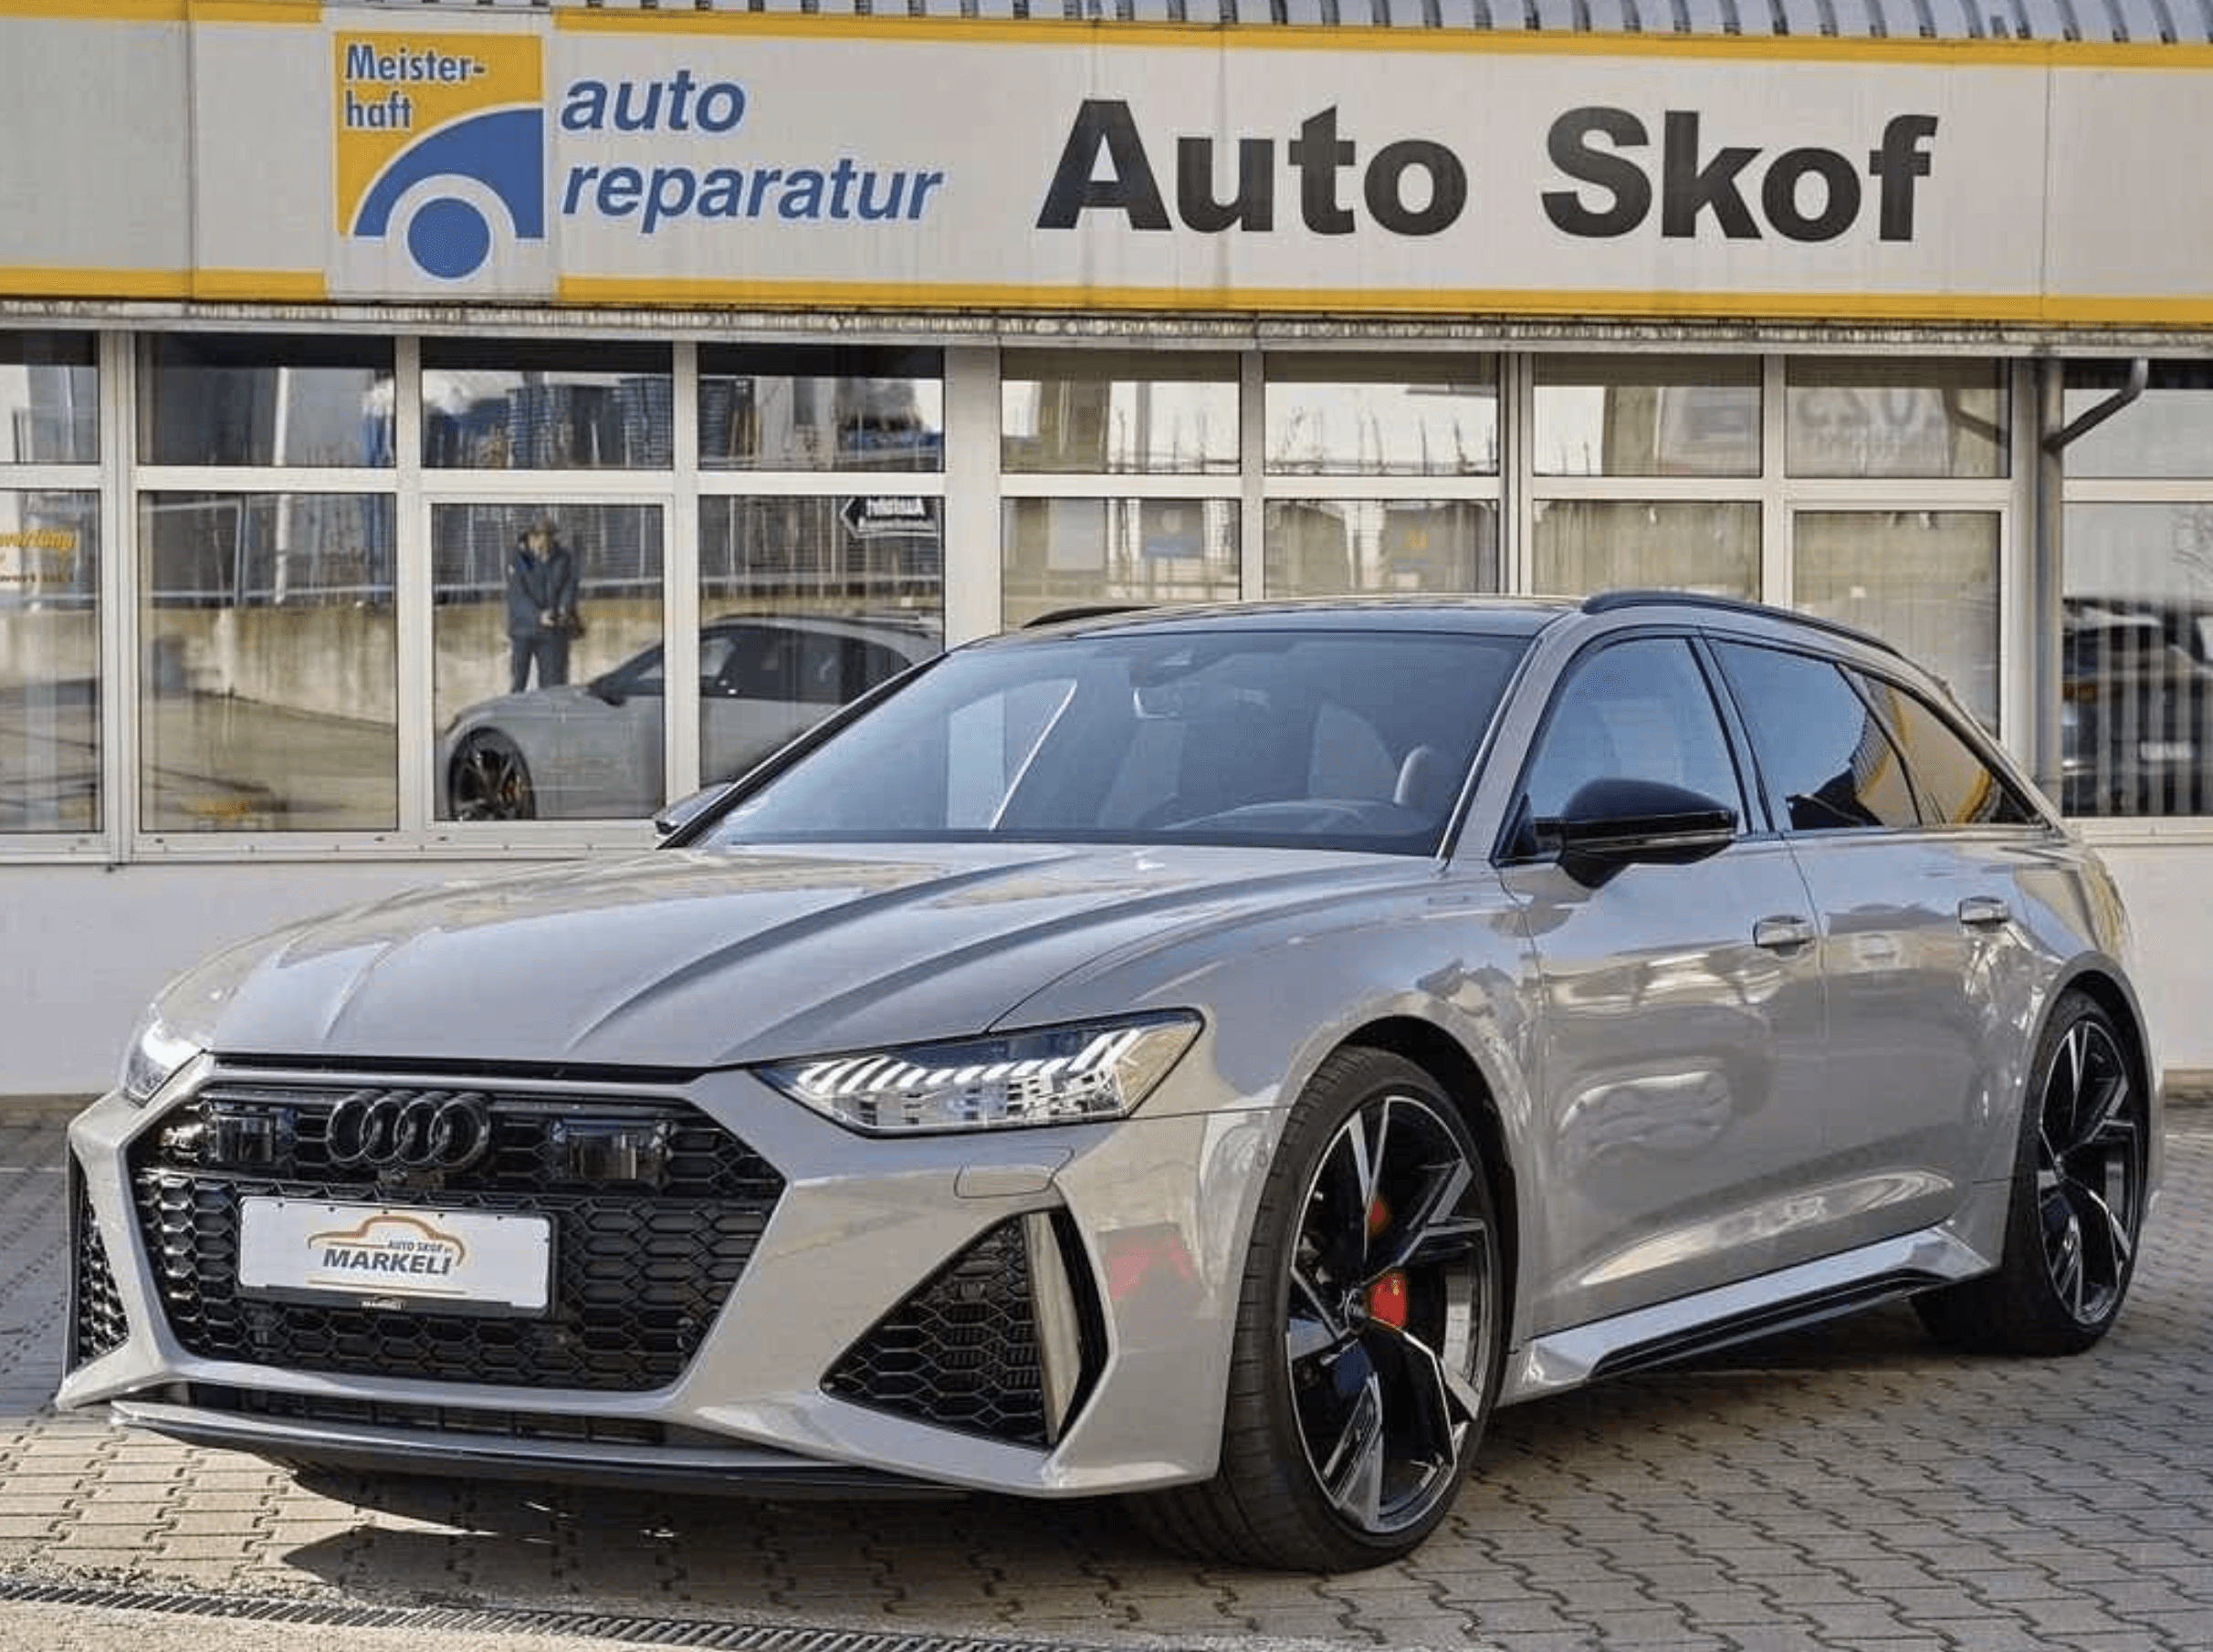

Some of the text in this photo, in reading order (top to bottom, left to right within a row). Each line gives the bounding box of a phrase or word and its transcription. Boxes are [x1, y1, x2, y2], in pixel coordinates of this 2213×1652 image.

[344, 45, 486, 82] Meister-
[346, 91, 412, 128] haft
[561, 69, 746, 131] auto
[1035, 99, 1938, 242] Auto Skof
[562, 158, 942, 234] reparatur
[323, 1249, 452, 1274] MARKELI
